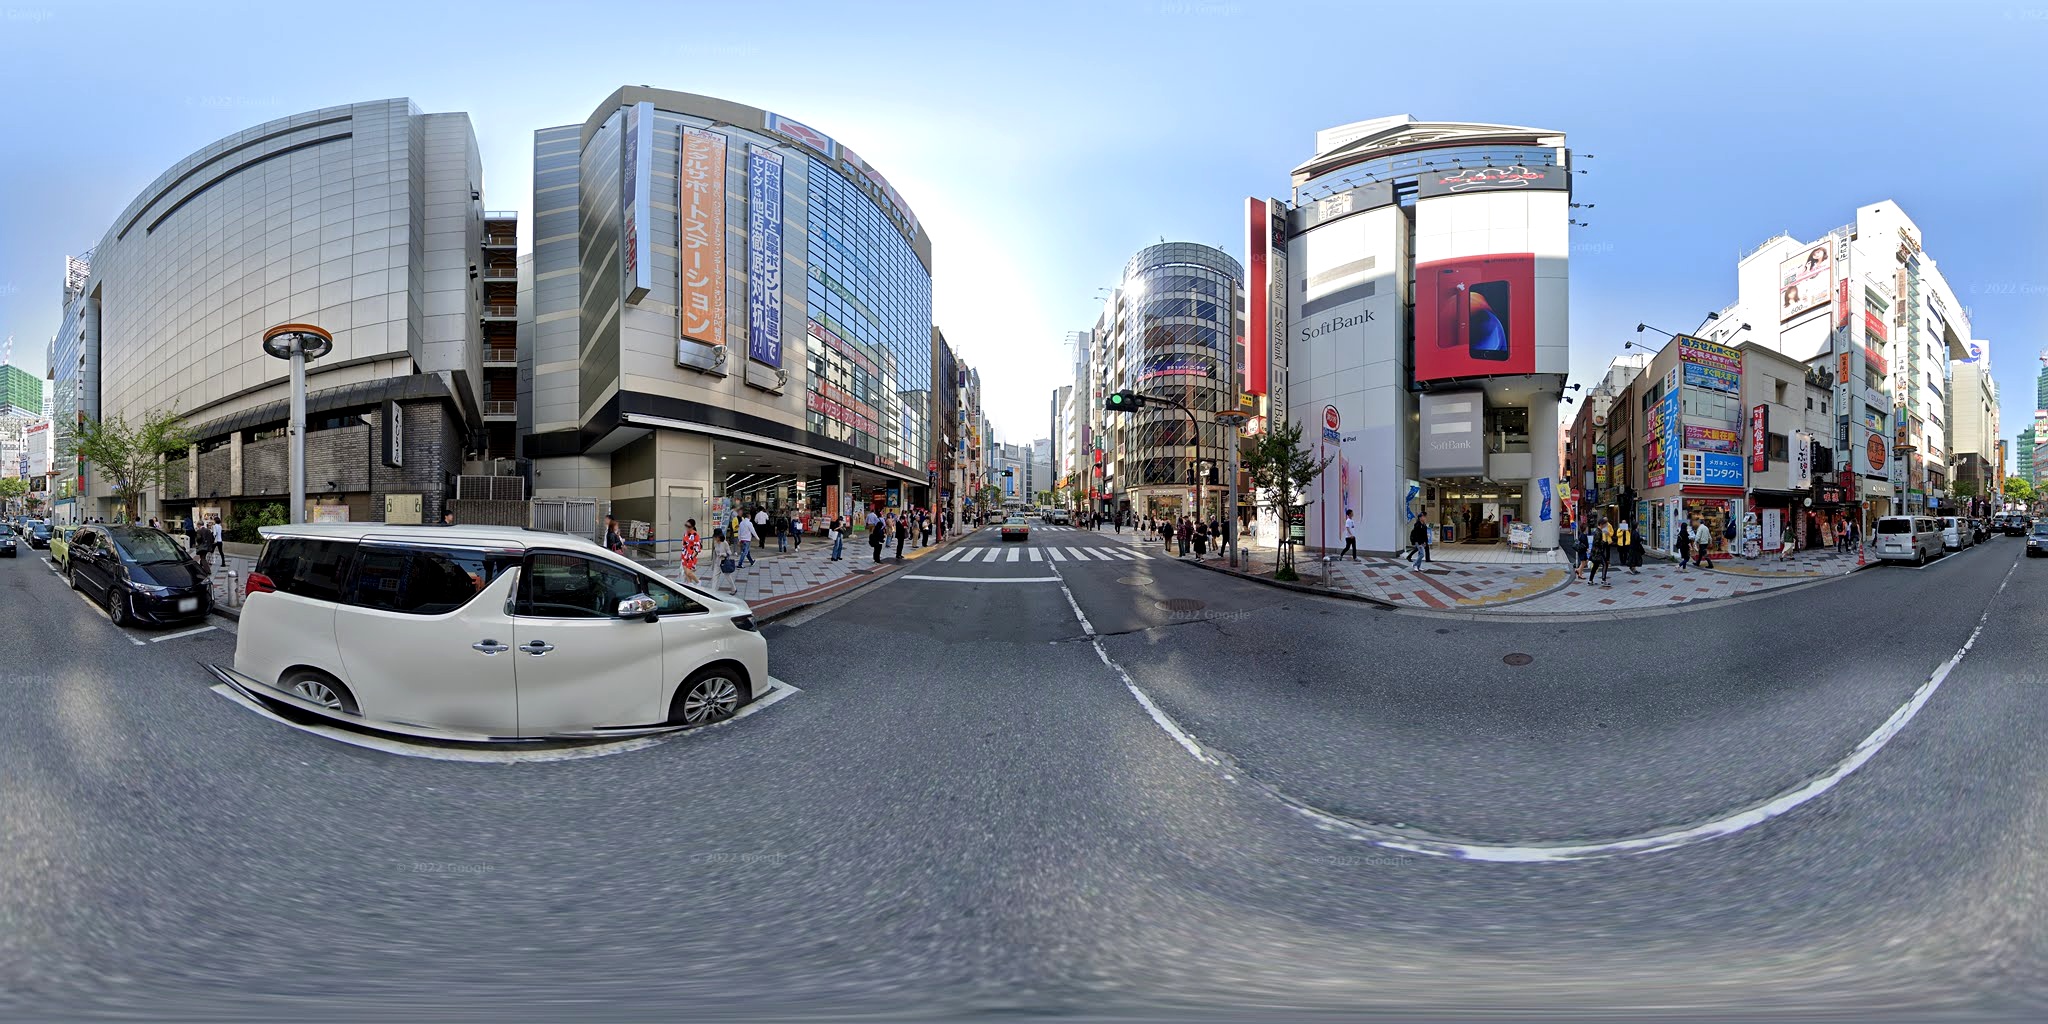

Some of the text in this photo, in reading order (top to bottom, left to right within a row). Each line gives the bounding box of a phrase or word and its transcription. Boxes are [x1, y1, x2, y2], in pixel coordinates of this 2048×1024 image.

[1274, 319, 1283, 361] SoftBank
[1301, 309, 1375, 342] SoftBank
[1430, 440, 1471, 450] SoftBank
[1665, 400, 1673, 478] コンタクト
[1706, 468, 1743, 479] コンタクト
